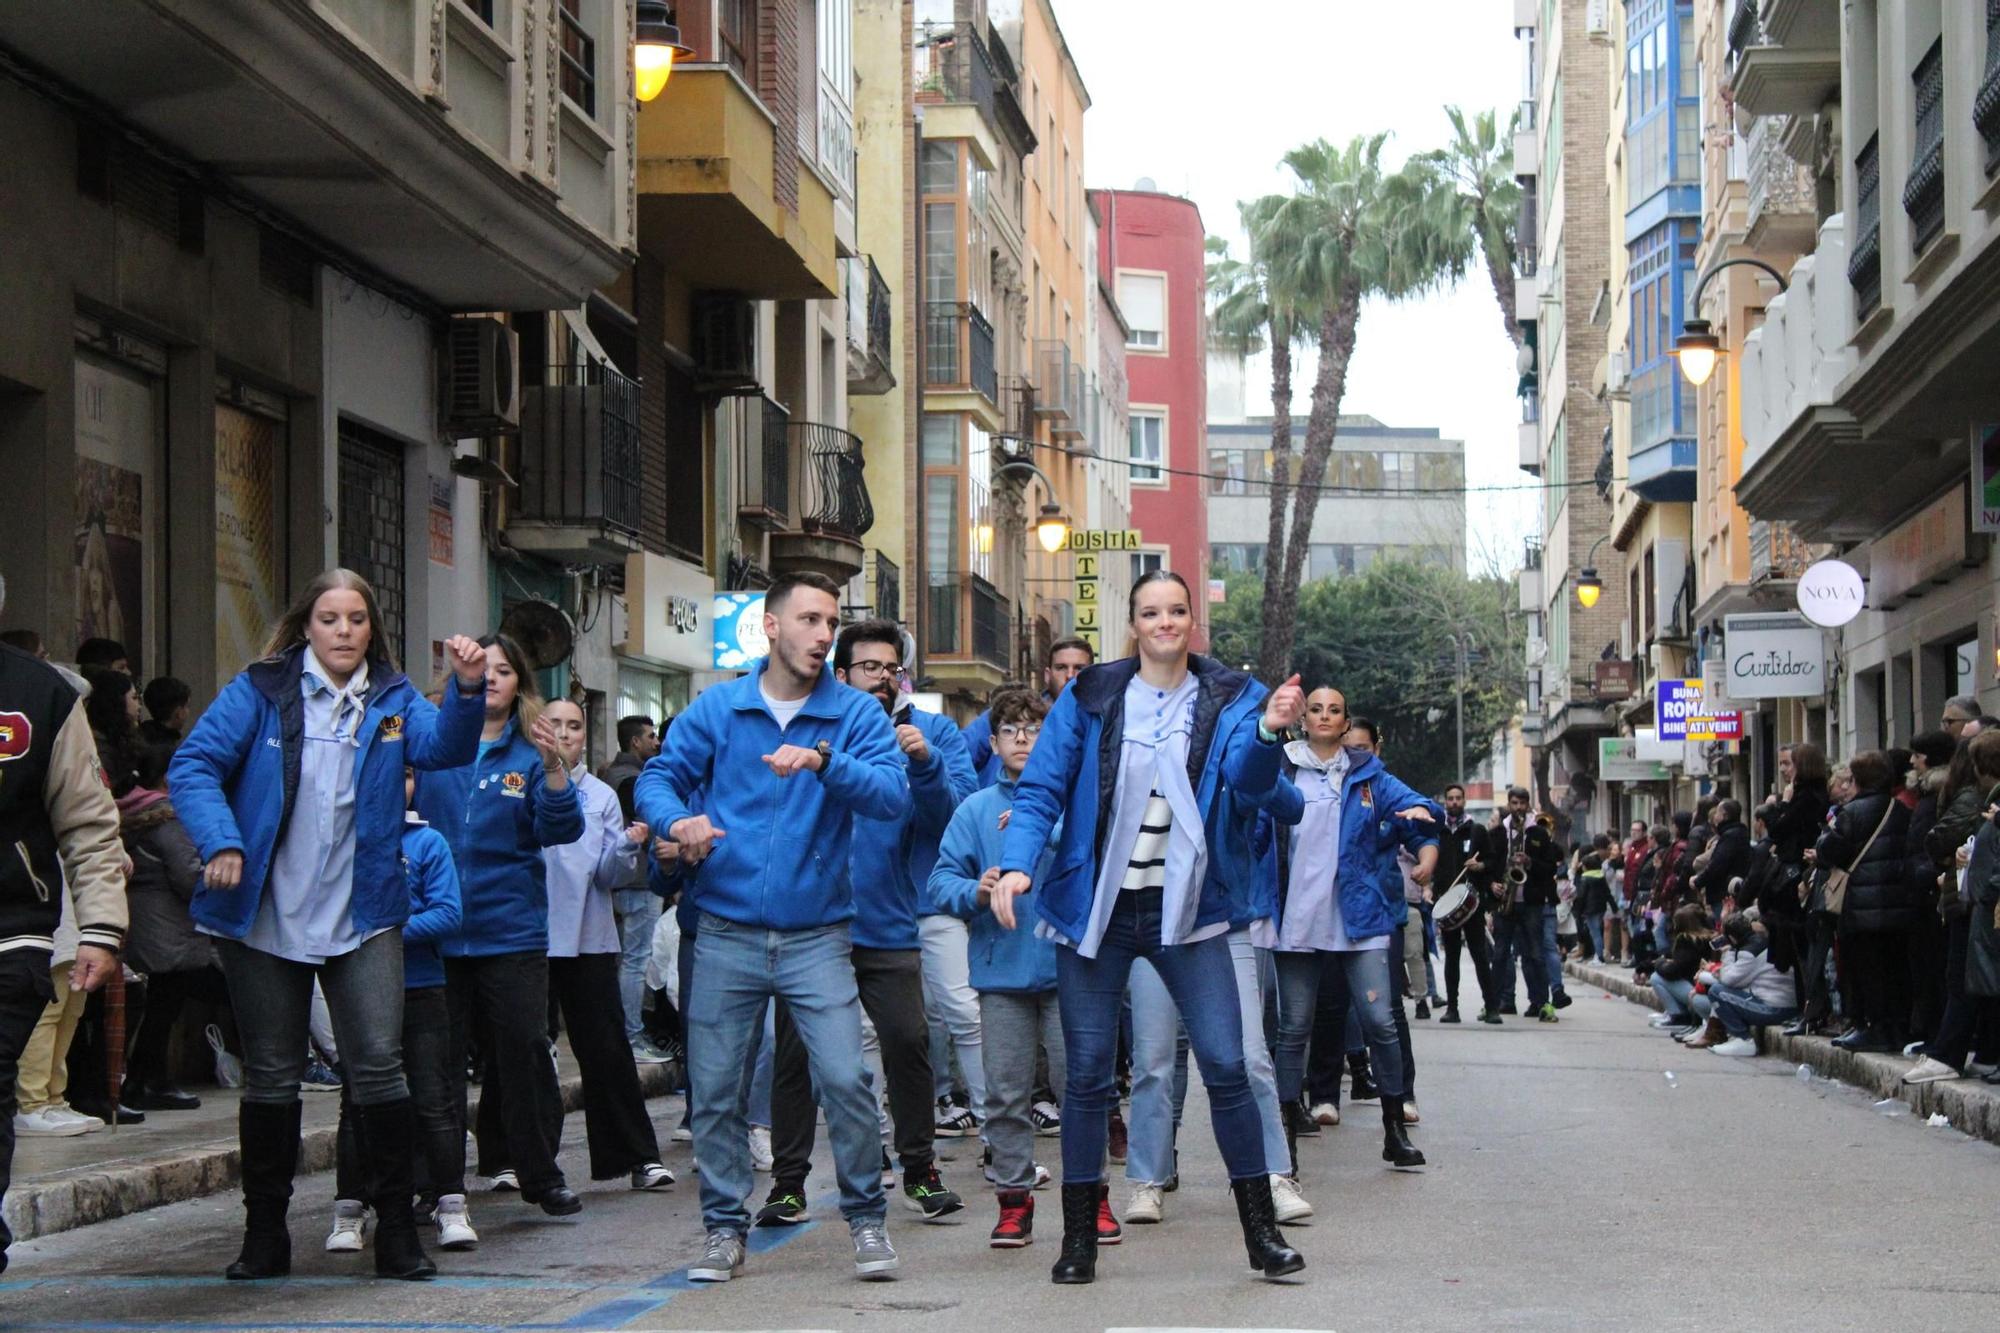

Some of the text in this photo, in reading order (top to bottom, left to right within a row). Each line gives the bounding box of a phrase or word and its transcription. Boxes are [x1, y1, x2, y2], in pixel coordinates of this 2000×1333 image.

[1805, 586, 1857, 600] NOVA
[1734, 650, 1816, 678] Curtidor
[1672, 688, 1700, 699] BUNA
[1663, 721, 1738, 733] BINE ATI VENIT
